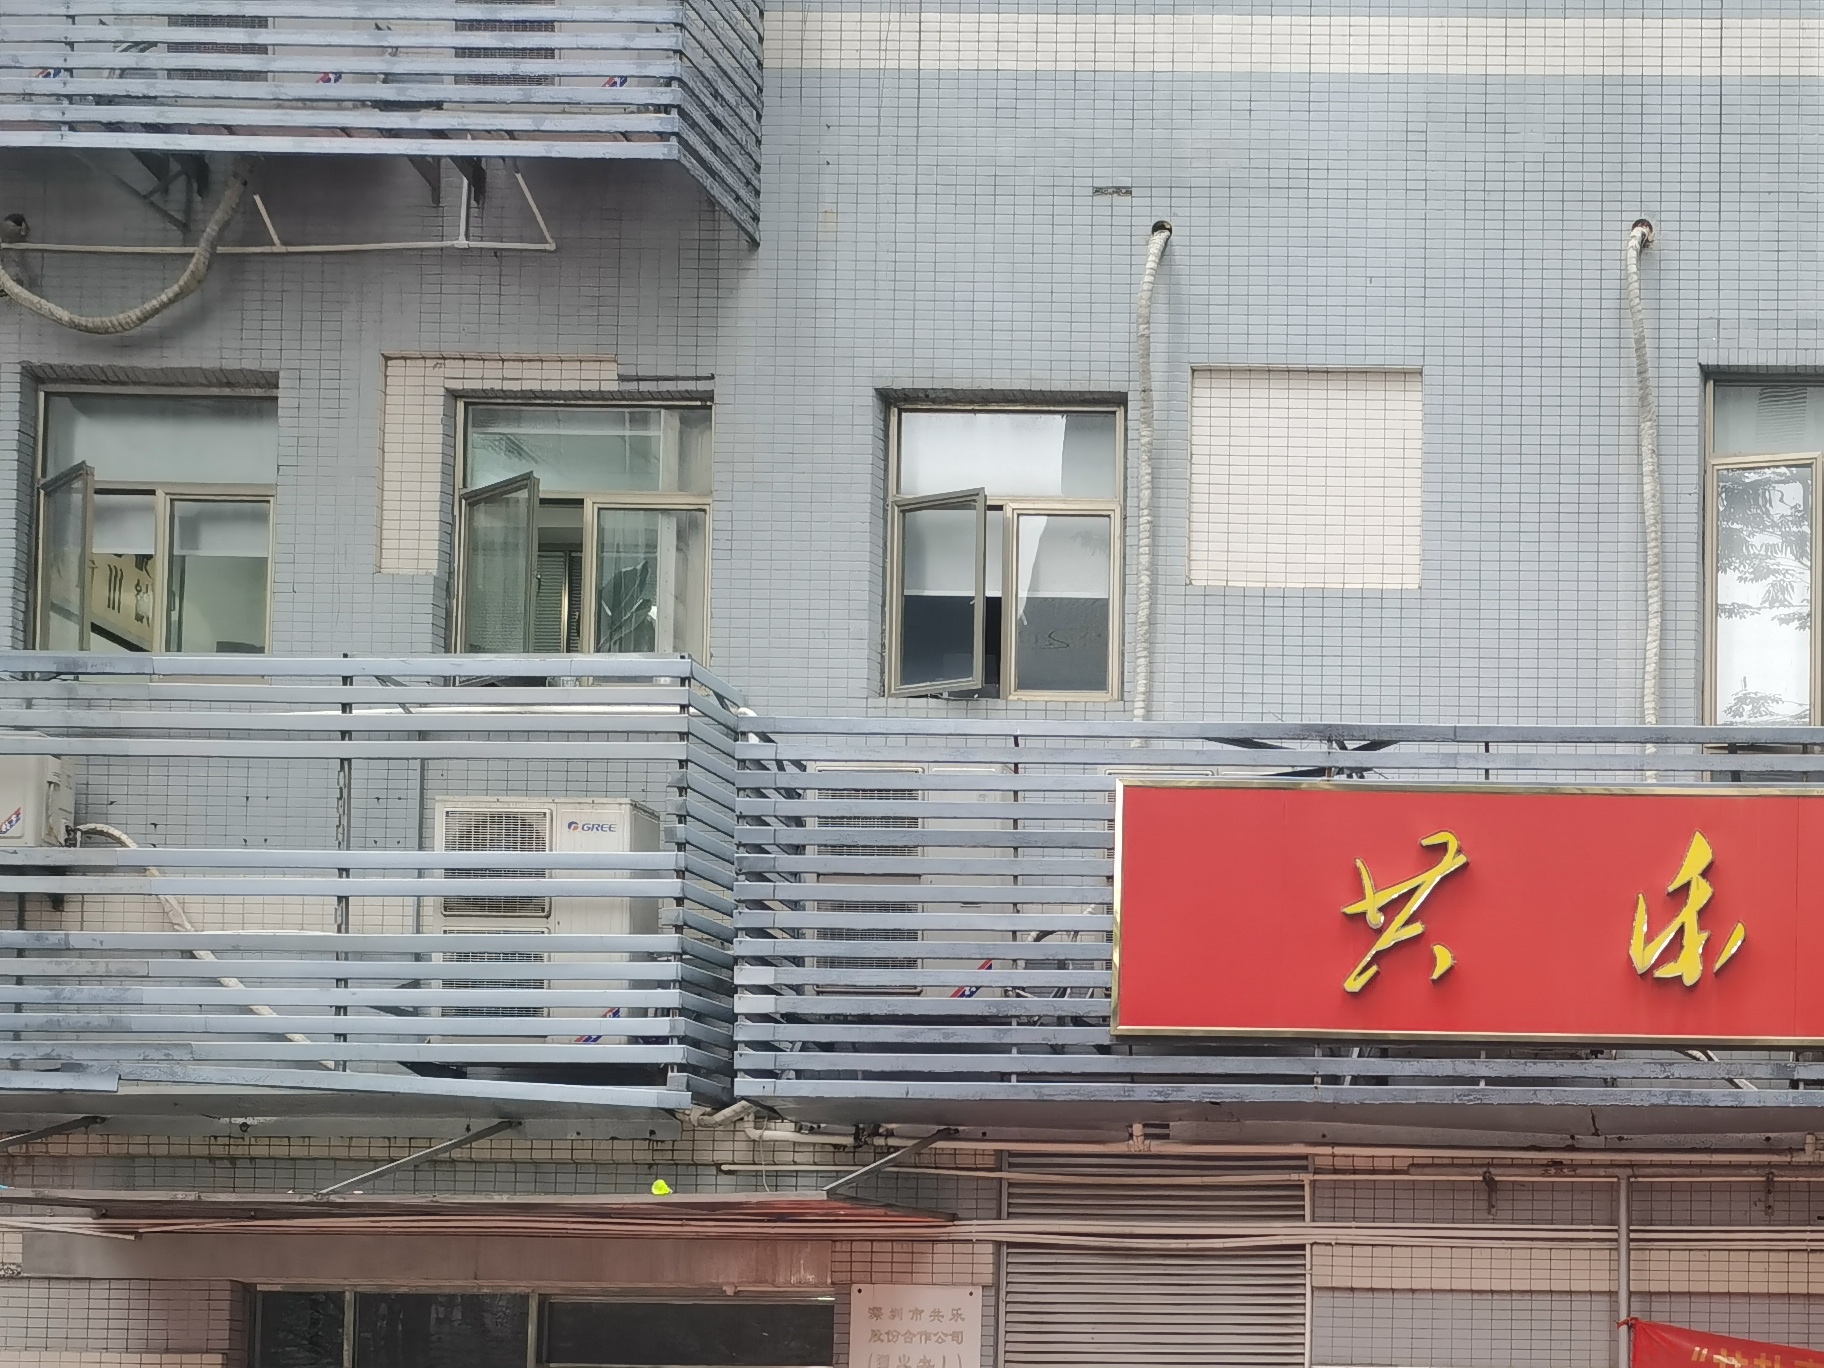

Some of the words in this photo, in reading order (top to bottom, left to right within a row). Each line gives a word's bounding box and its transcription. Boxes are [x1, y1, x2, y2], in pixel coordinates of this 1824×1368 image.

[582, 823, 617, 832] GREE
[867, 1306, 966, 1323] 深圳市共乐
[868, 1329, 964, 1345] 股份合作公司
